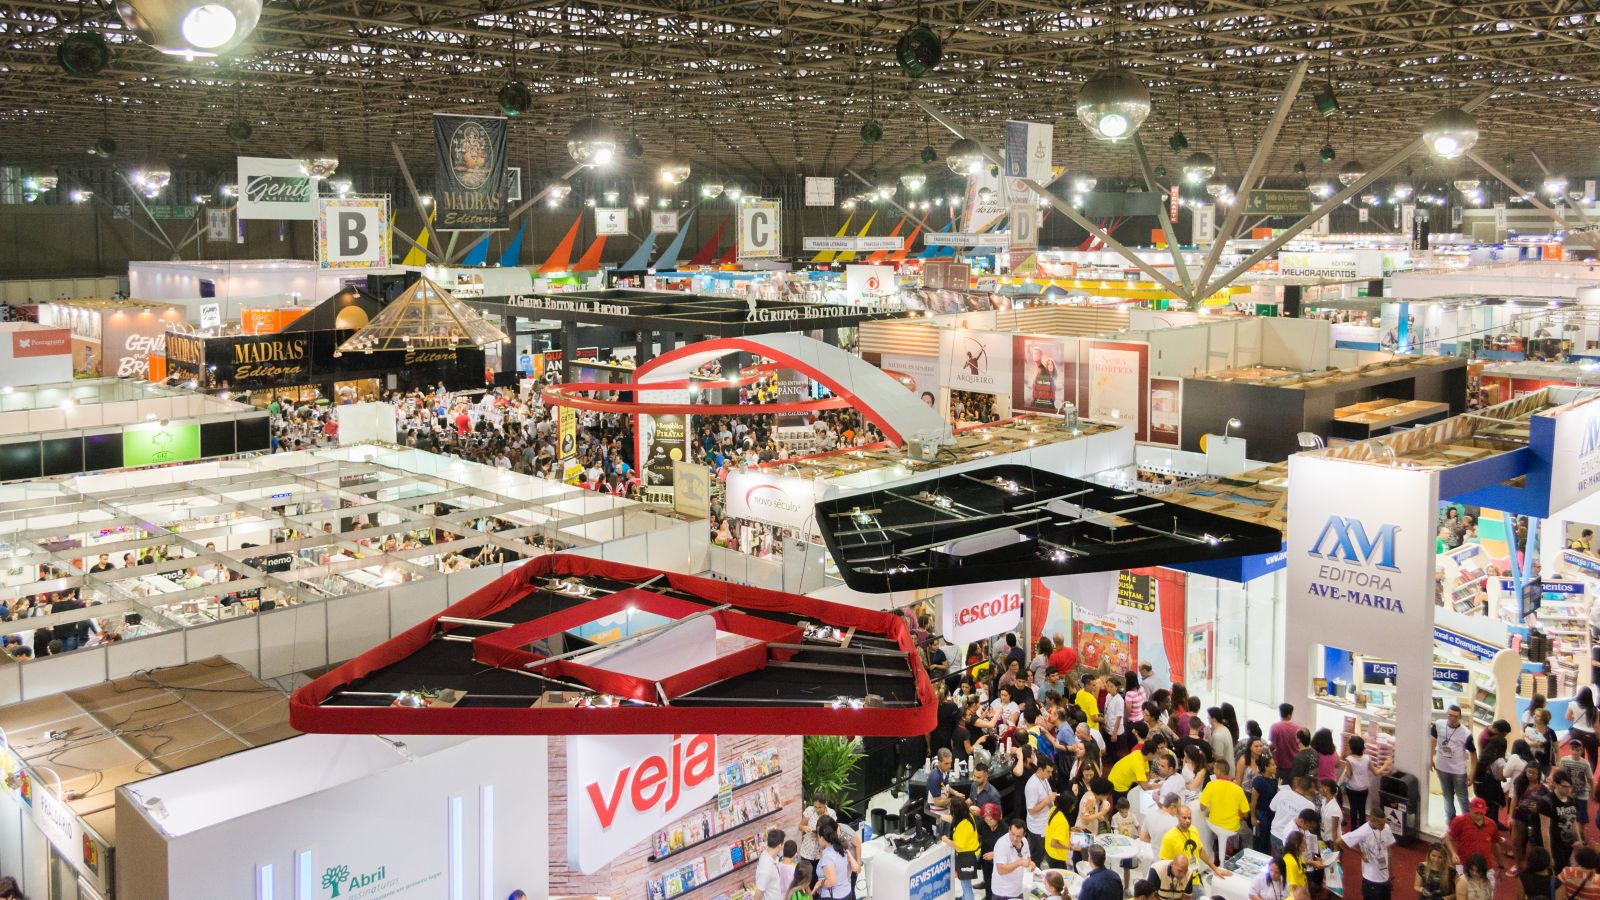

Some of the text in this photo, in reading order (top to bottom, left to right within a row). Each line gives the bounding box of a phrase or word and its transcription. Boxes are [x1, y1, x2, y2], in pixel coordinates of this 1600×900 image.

[444, 191, 500, 210] MADRAS
[444, 212, 497, 224] Editora
[1017, 212, 1030, 241] D
[1200, 212, 1208, 237] E
[338, 211, 369, 256] B
[751, 211, 769, 248] C
[1281, 268, 1357, 279] MELHORAMENTOS
[545, 297, 590, 313] EDITORIAL
[593, 301, 630, 316] RECORD
[759, 308, 799, 323] GRUPO
[804, 304, 863, 319] EDITORIAL
[167, 335, 200, 365] MADRAS
[234, 340, 304, 364] MADRAS
[404, 351, 457, 365] Editora
[1094, 363, 1134, 374] ROBERTS
[1102, 357, 1126, 366] NORA
[234, 365, 302, 380] Editora
[956, 374, 994, 385] ARQUEIRO
[656, 430, 684, 438] PIRATAS
[754, 496, 798, 513] novo século
[267, 556, 292, 566] nemo
[1318, 565, 1393, 592] EDITORA
[1307, 582, 1405, 614] AVE-MARIA
[959, 593, 1021, 626] escola
[586, 734, 716, 830] veja
[348, 865, 385, 891] Abril
[910, 858, 951, 889] REVISTARIA
